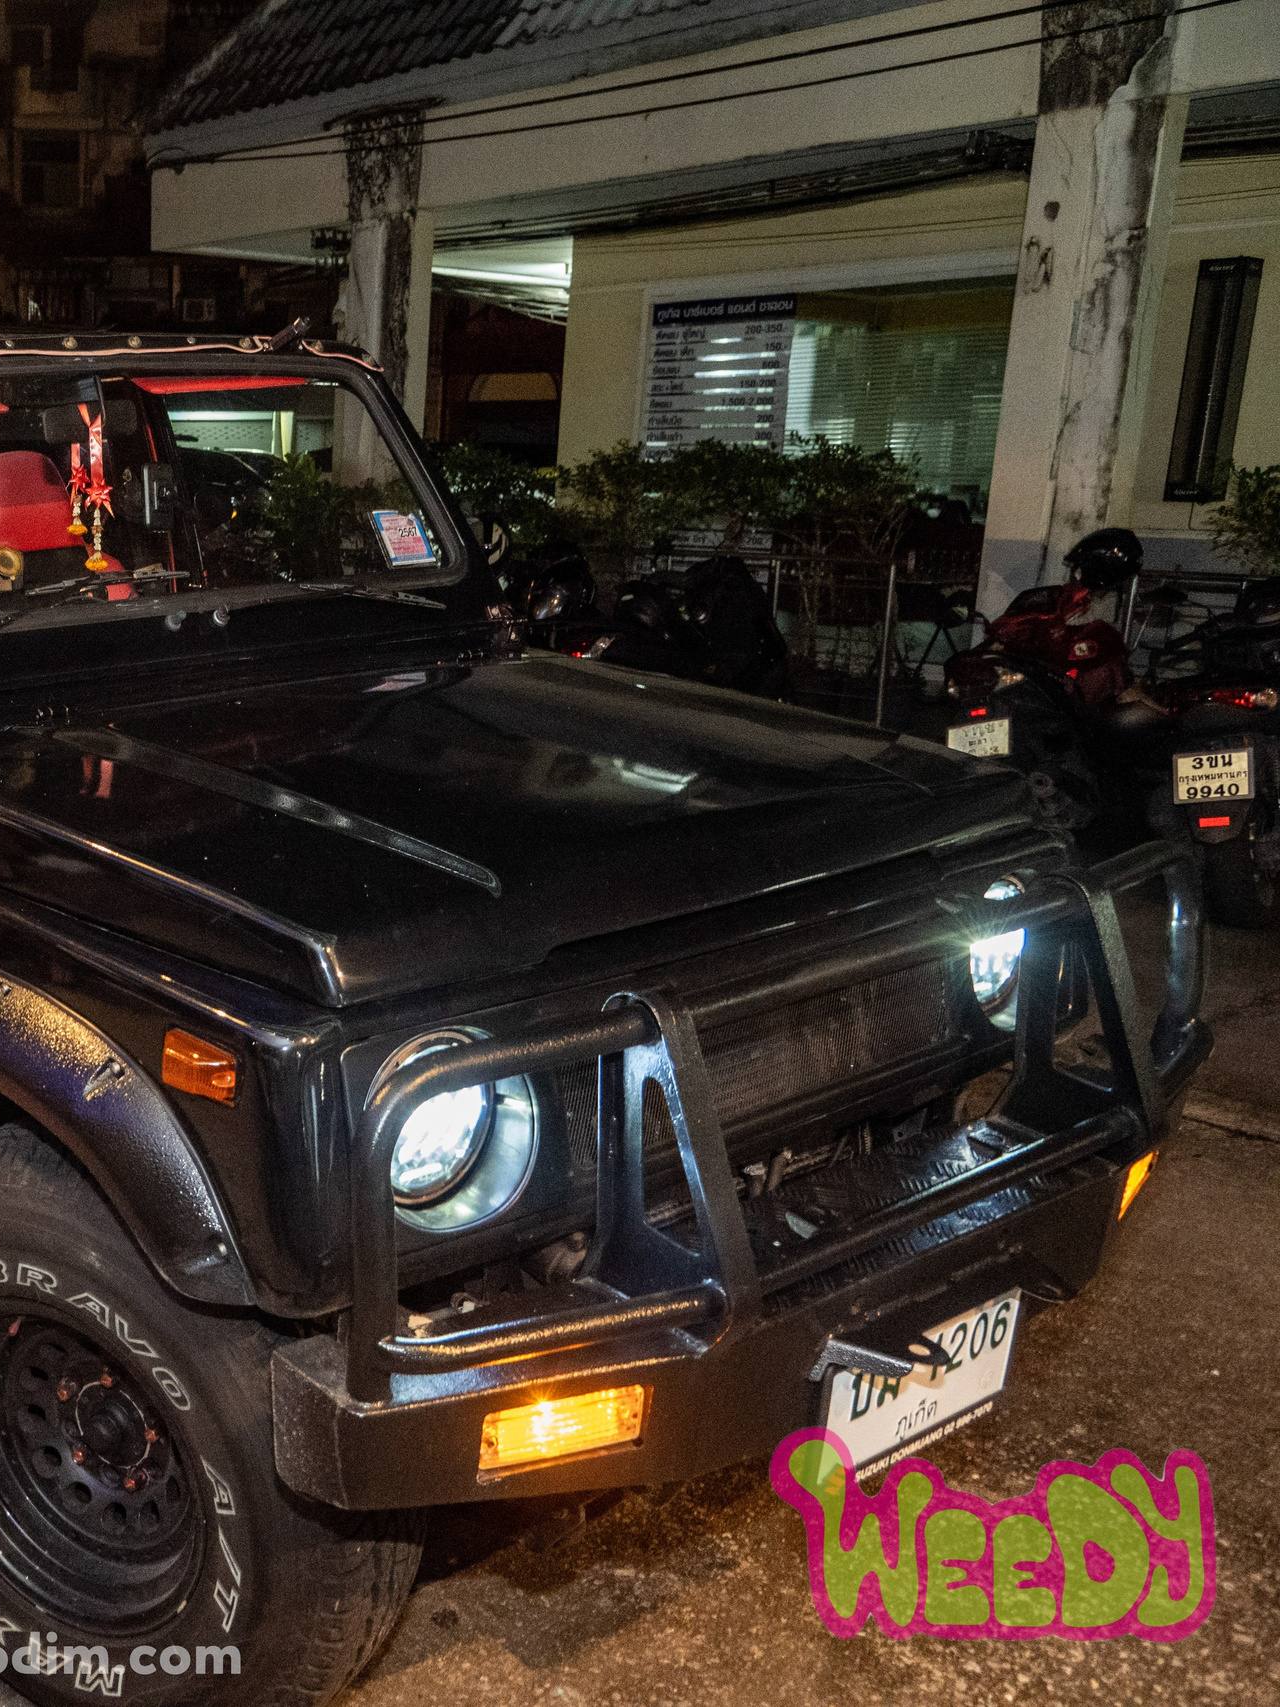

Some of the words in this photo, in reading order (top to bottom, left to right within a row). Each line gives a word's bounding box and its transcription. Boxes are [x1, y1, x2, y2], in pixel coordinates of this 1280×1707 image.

[399, 527, 418, 537] 2567
[1192, 754, 1233, 769] 3ขน
[1179, 771, 1247, 784] กรุงเทพมหานคร
[1186, 783, 1239, 799] 9940
[894, 1397, 938, 1442] ภูเก็ต
[854, 1456, 890, 1482] SUZUKI
[201, 1455, 242, 1632] A/T
